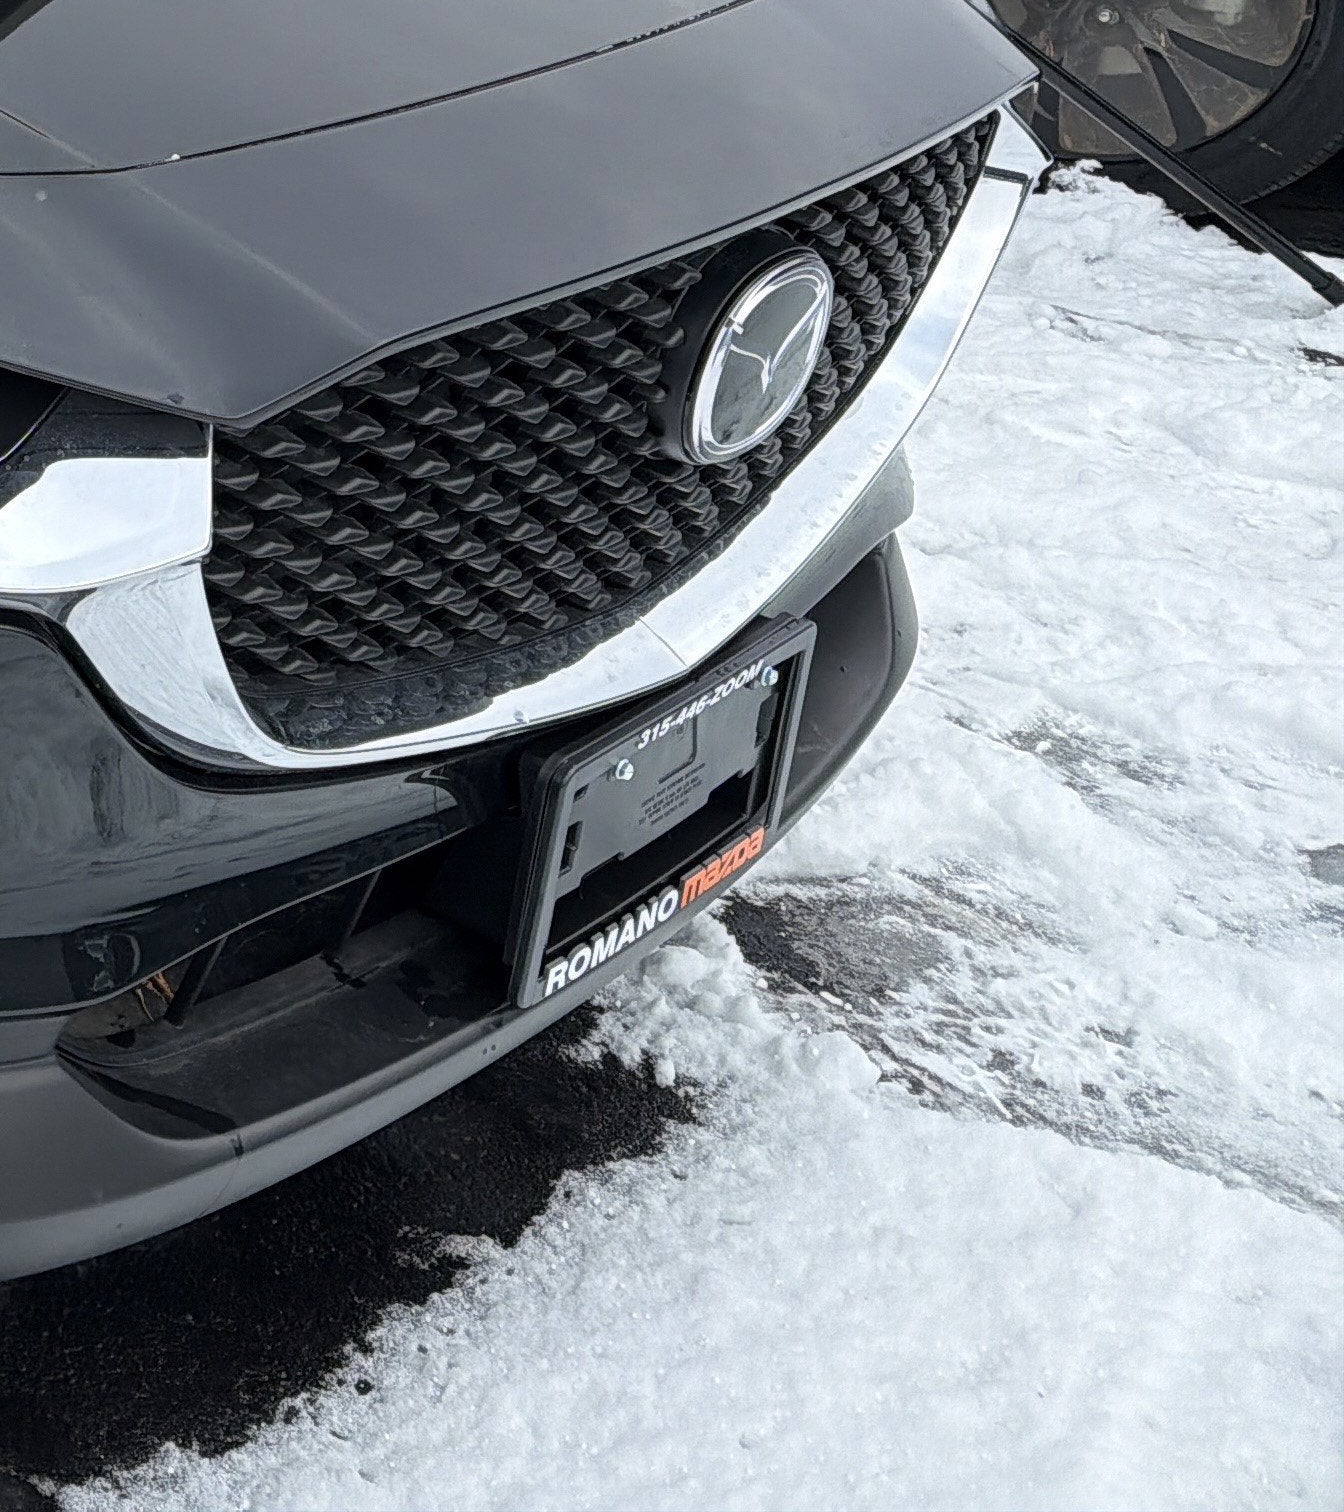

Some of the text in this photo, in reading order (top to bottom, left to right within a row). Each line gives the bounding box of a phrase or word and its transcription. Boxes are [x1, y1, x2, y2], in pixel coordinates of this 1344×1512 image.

[637, 658, 765, 750] 315-446-ZOOM
[543, 825, 765, 998] ROMANO mazda
